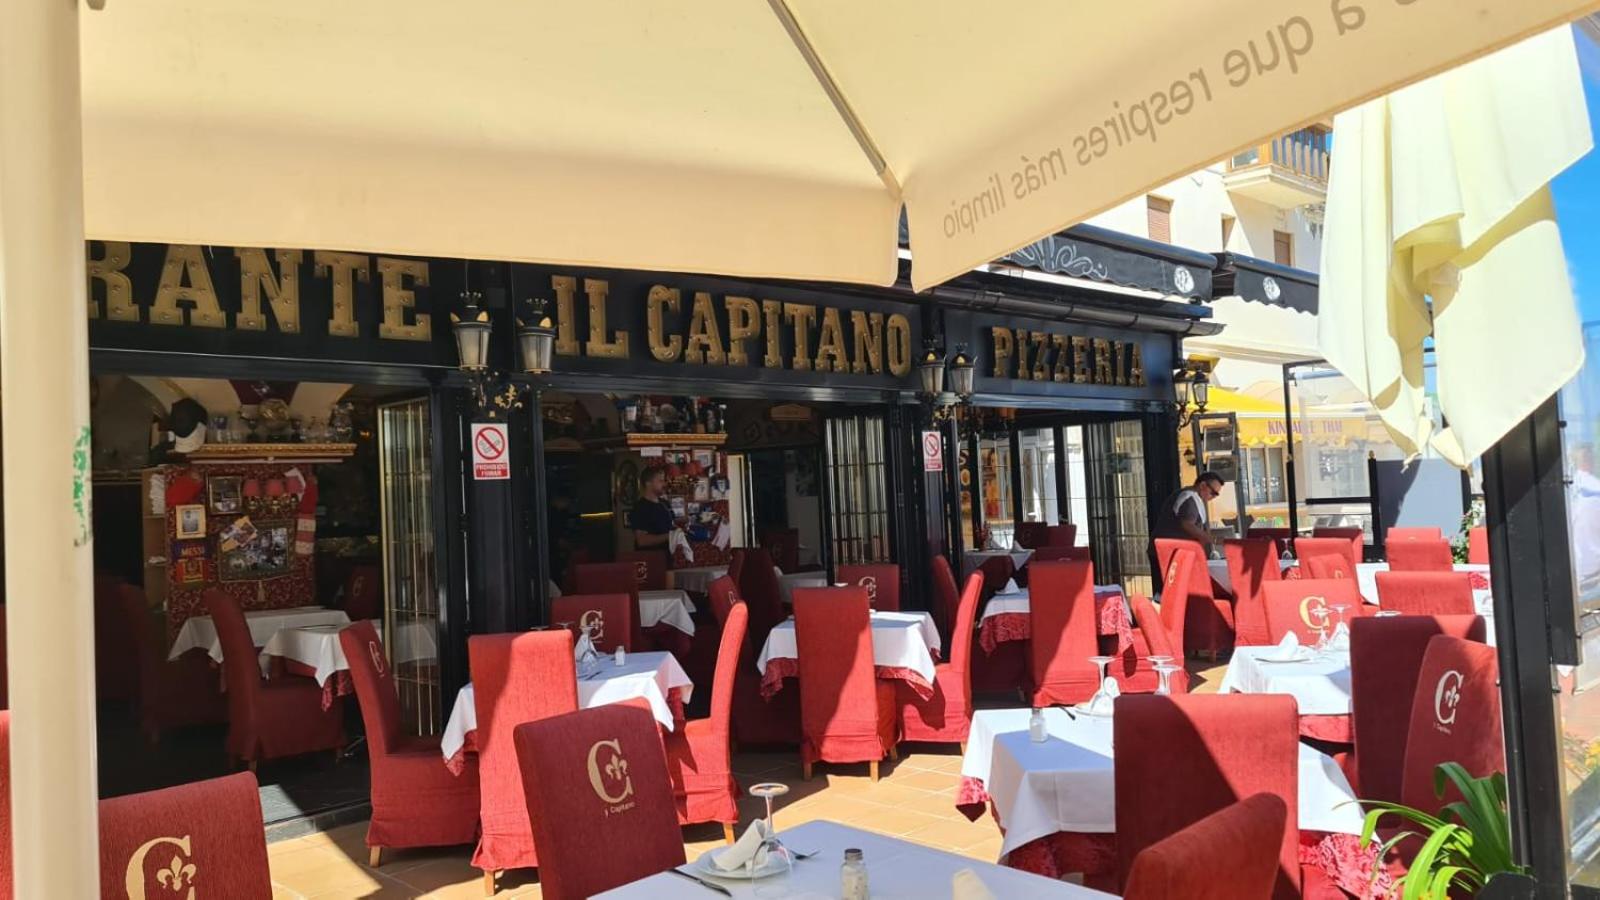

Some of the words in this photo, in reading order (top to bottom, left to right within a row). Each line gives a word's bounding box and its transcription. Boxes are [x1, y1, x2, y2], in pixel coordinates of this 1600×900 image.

[551, 274, 630, 360] IL
[646, 284, 912, 377] CAPITANO
[991, 326, 1147, 388] PIZZERIA
[1434, 670, 1465, 724] C
[587, 738, 633, 804] C
